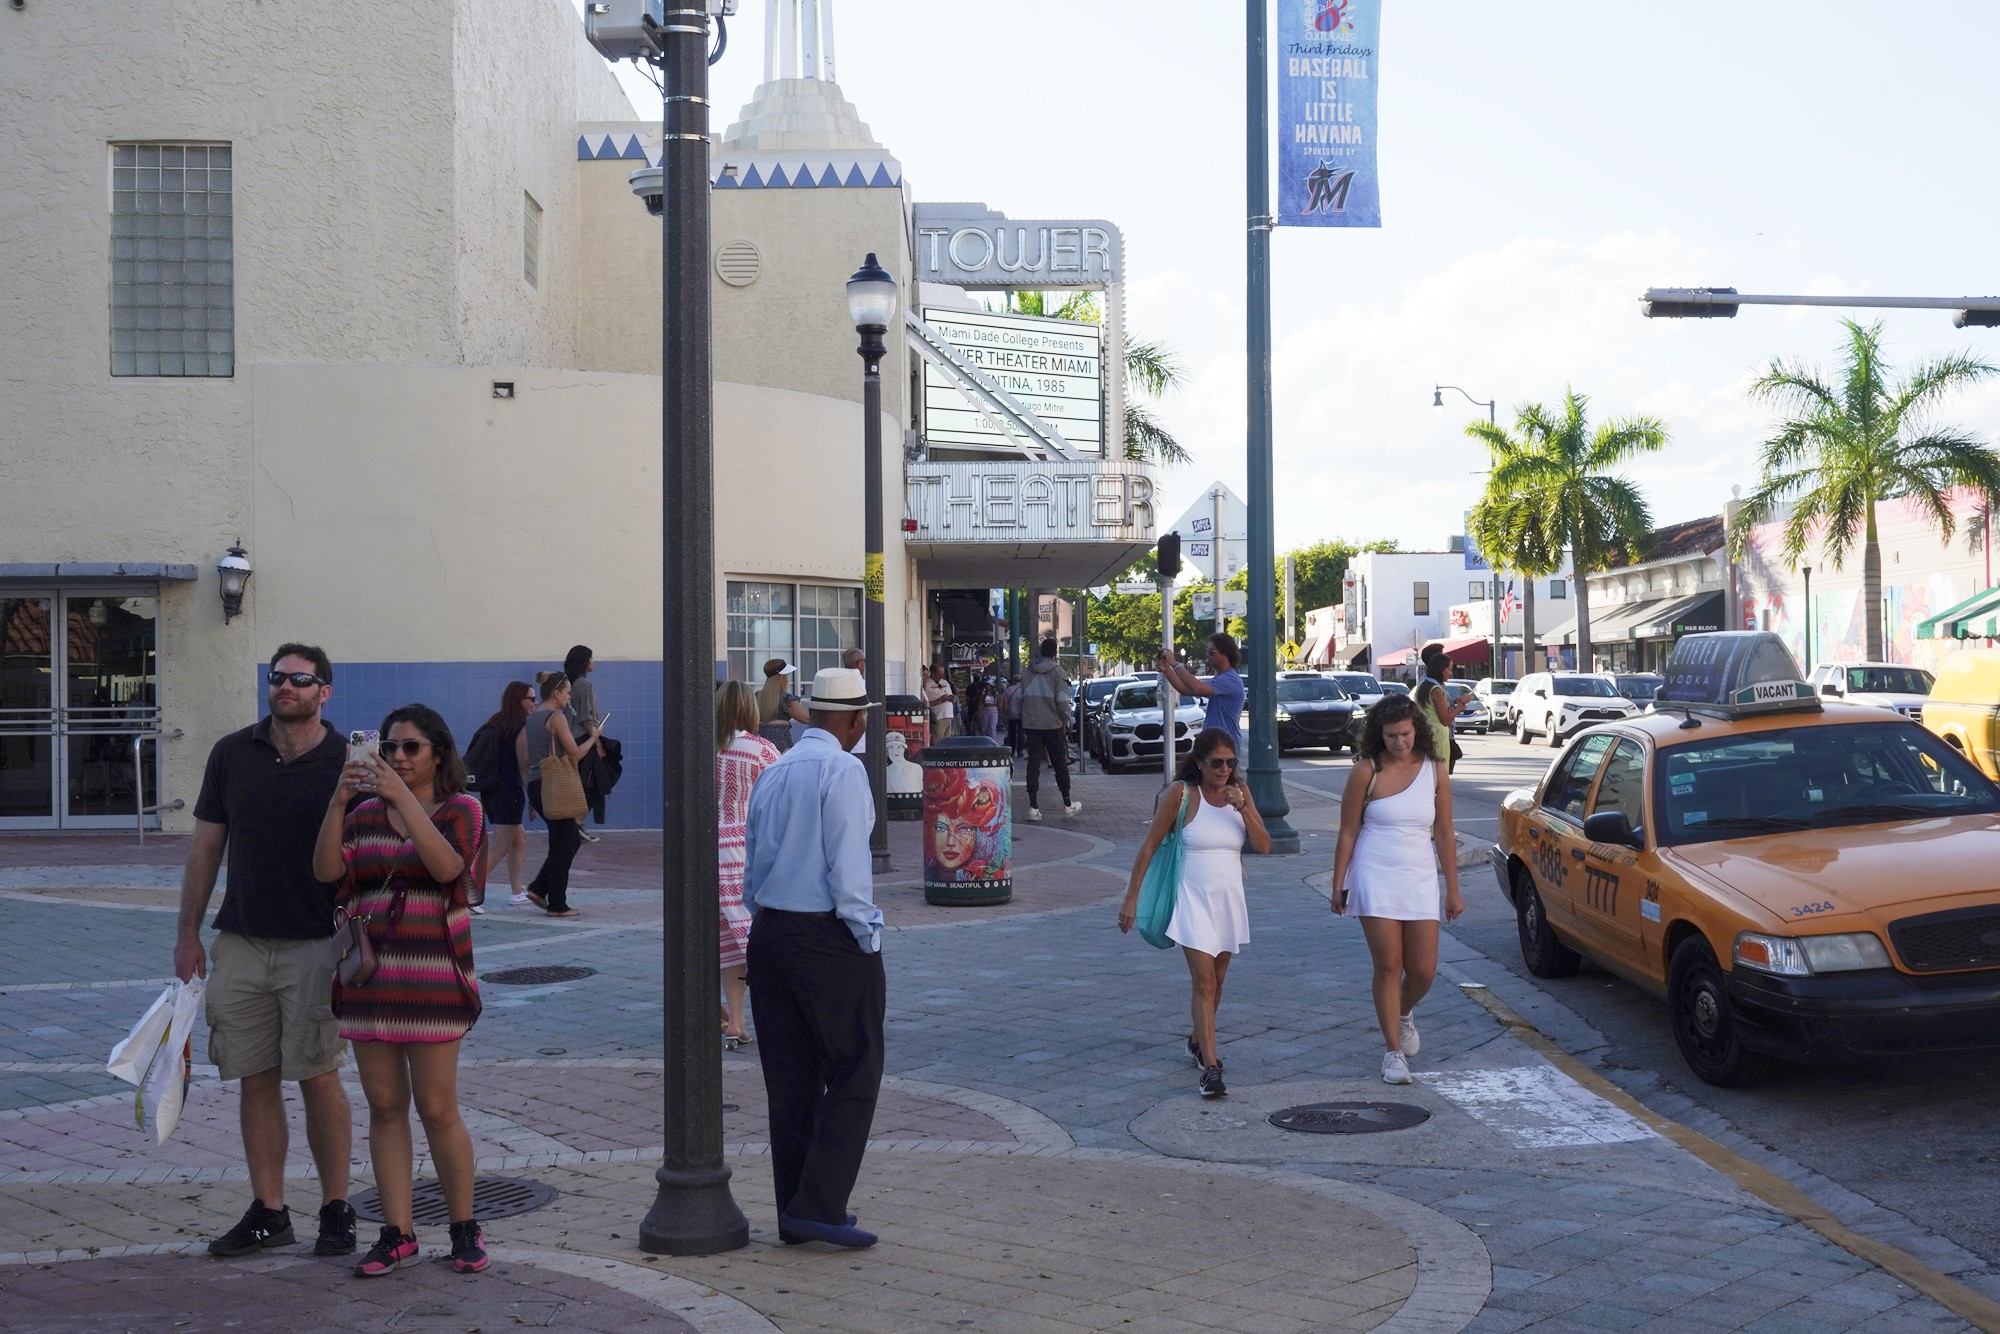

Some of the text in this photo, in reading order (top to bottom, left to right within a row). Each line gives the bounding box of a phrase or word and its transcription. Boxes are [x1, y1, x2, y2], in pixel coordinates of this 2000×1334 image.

[1304, 31, 1355, 41] CULTURALES
[1288, 43, 1373, 58] Third Fridays
[1288, 57, 1369, 79] BASEBALL
[1321, 80, 1337, 99] IS
[1305, 102, 1353, 122] LITTLE
[1295, 124, 1363, 145] HAVANA
[1303, 147, 1355, 156] SPONSORED BY
[919, 227, 1110, 273] TOWER
[938, 326, 1084, 351] Miami Dade College Presents
[987, 351, 1048, 370] THEATER
[1051, 358, 1092, 374] MIAMI
[1037, 379, 1065, 393] 1985
[1044, 403, 1065, 412] Mitre
[907, 473, 1154, 528] THEATER
[1669, 674, 1710, 685] VODKA
[1755, 684, 1794, 699] VACANT
[1585, 865, 1620, 916] 7777
[1790, 901, 1834, 916] 3424
